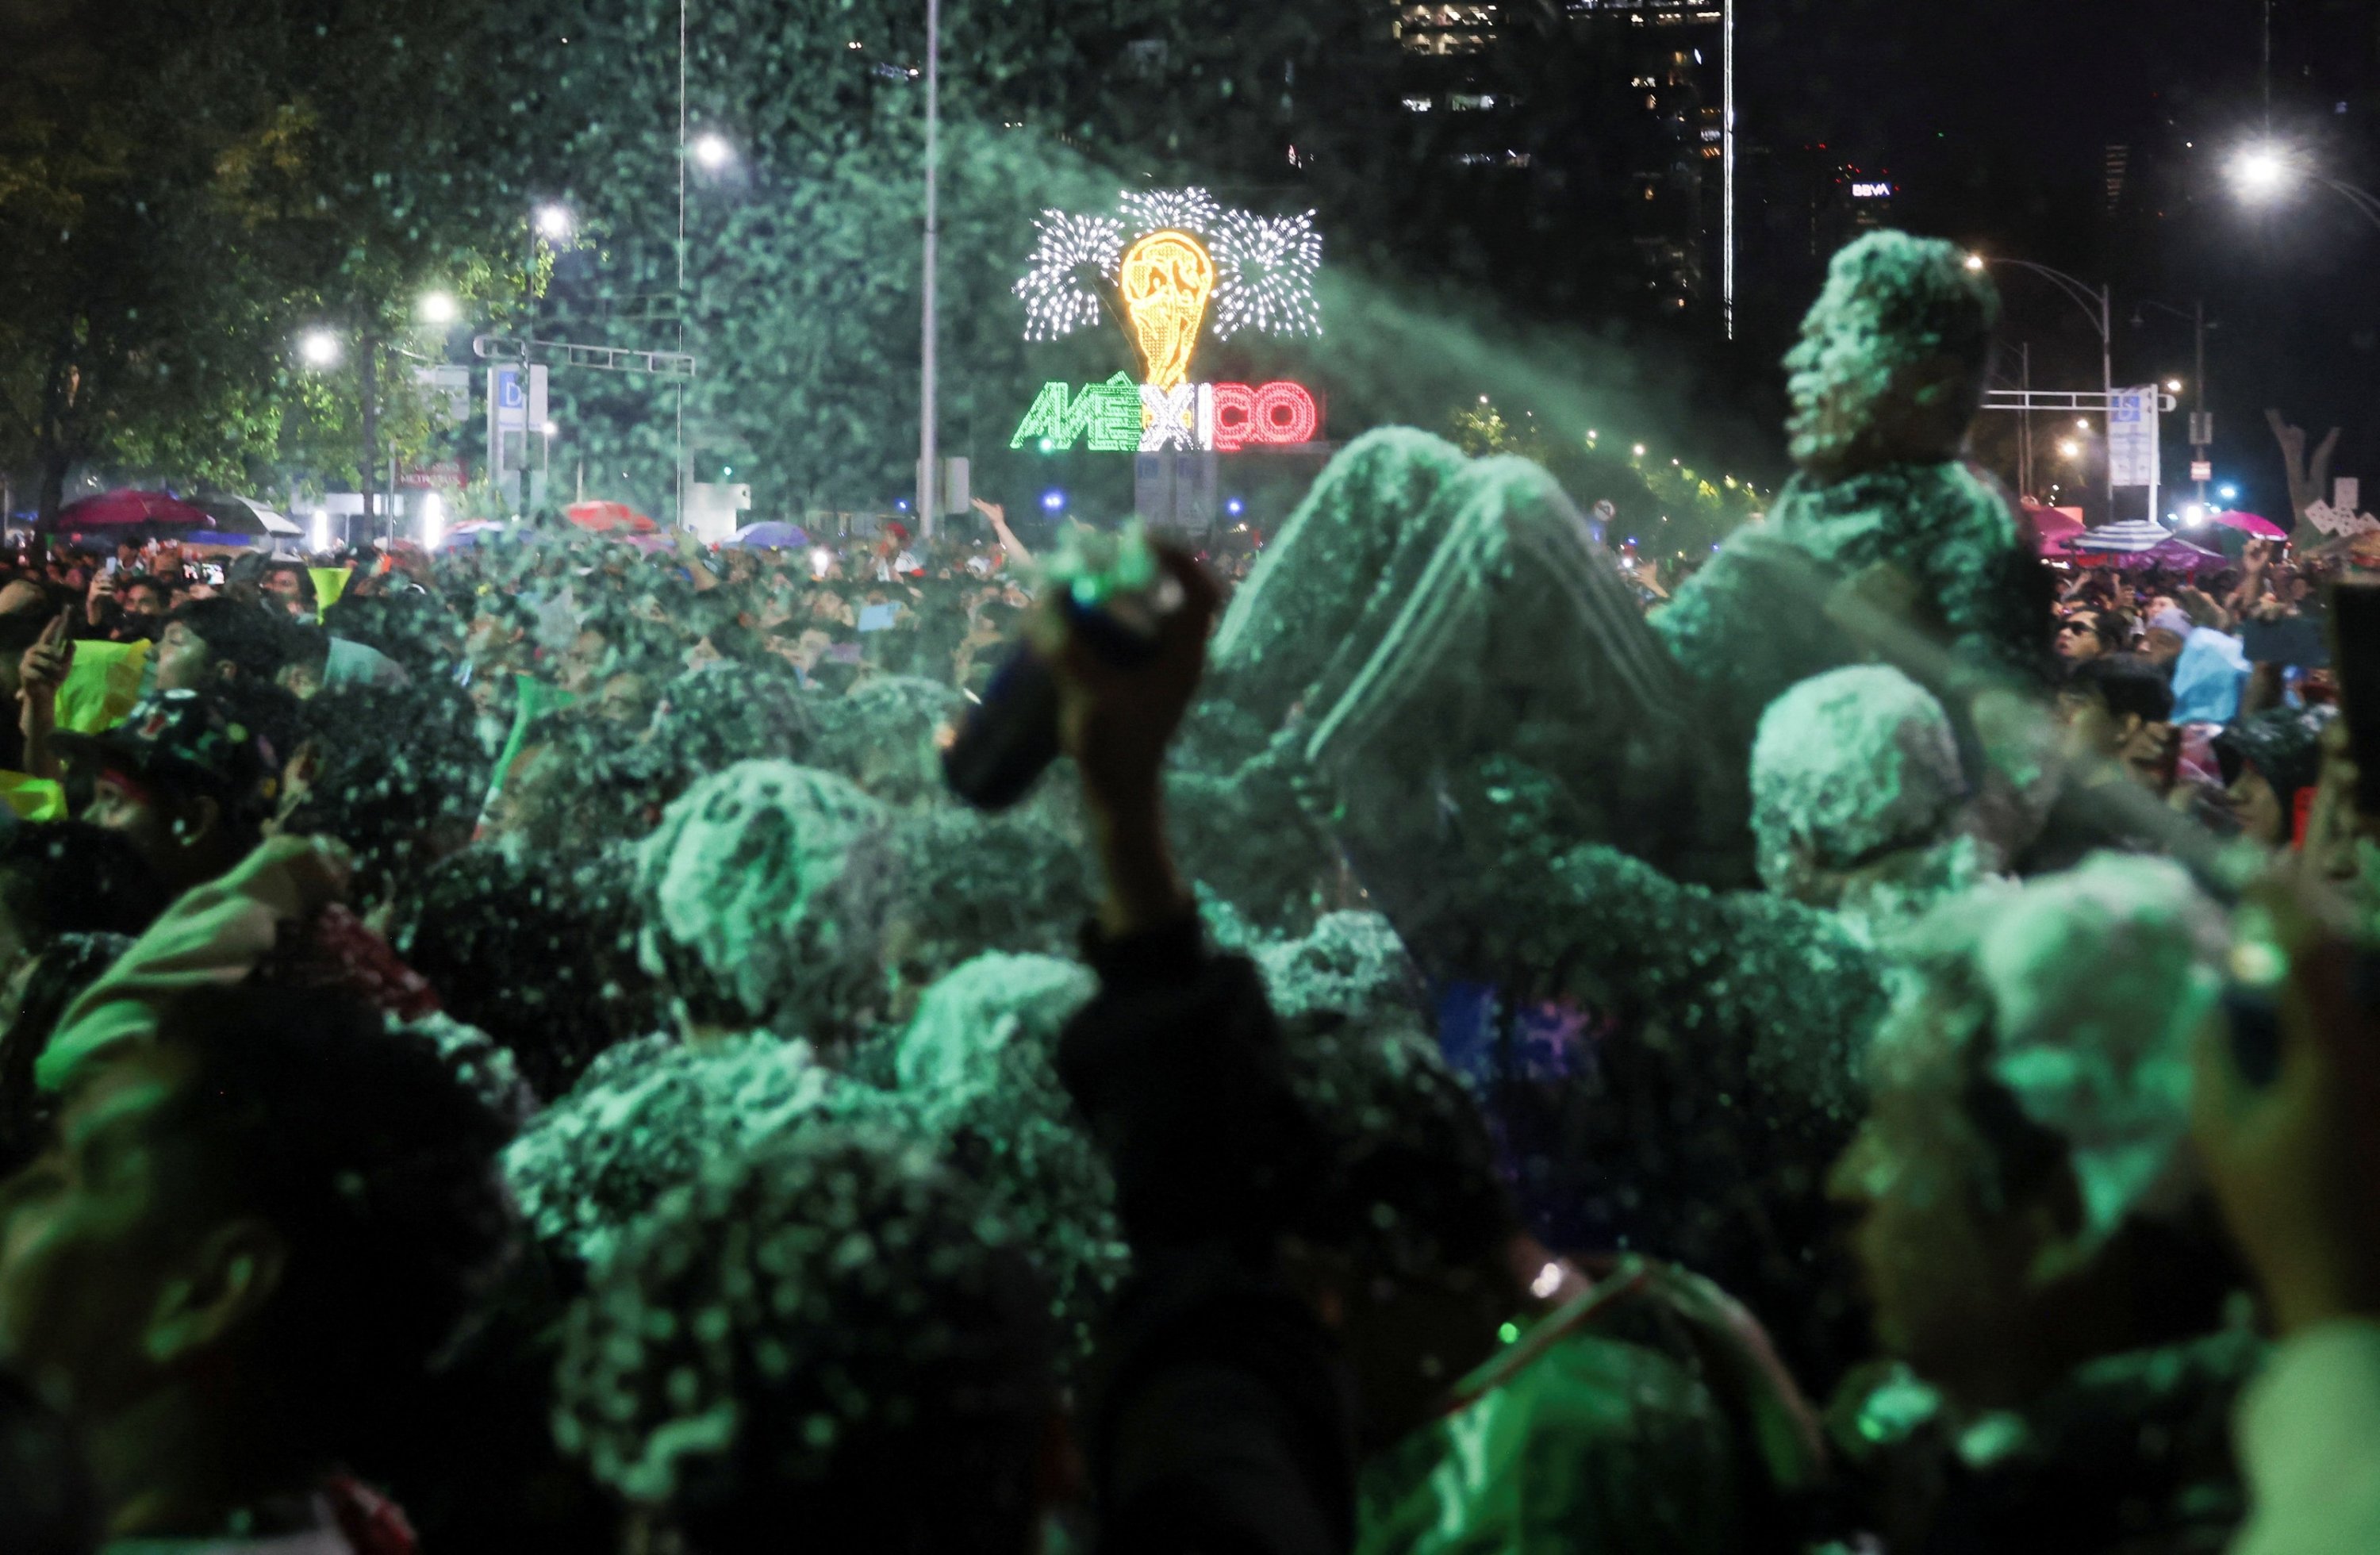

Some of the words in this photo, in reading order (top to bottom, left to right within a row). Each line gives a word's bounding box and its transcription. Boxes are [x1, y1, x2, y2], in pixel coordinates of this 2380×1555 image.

[1852, 182, 1891, 197] BBVA
[505, 382, 522, 406] D
[1009, 371, 1318, 451] MÉXICO
